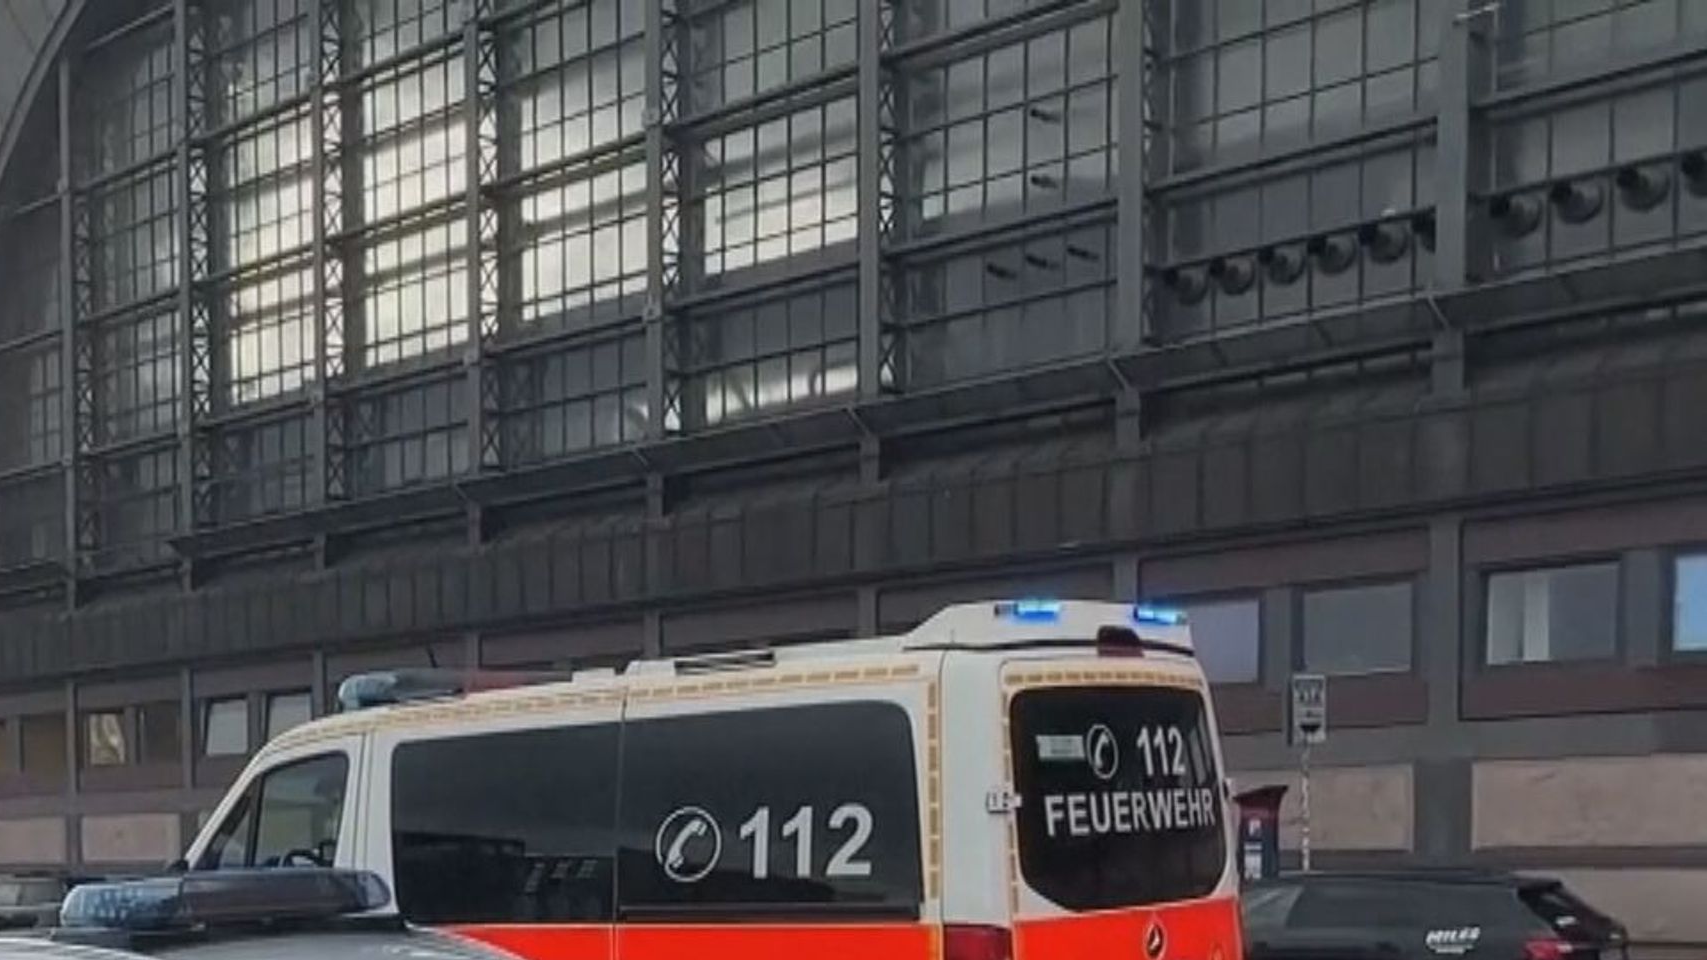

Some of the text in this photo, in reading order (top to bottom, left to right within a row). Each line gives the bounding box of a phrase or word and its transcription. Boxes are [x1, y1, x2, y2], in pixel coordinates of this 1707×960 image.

[1137, 725, 1186, 776] 112
[1045, 787, 1215, 837] FEUERWEHR
[740, 802, 872, 879] 112
